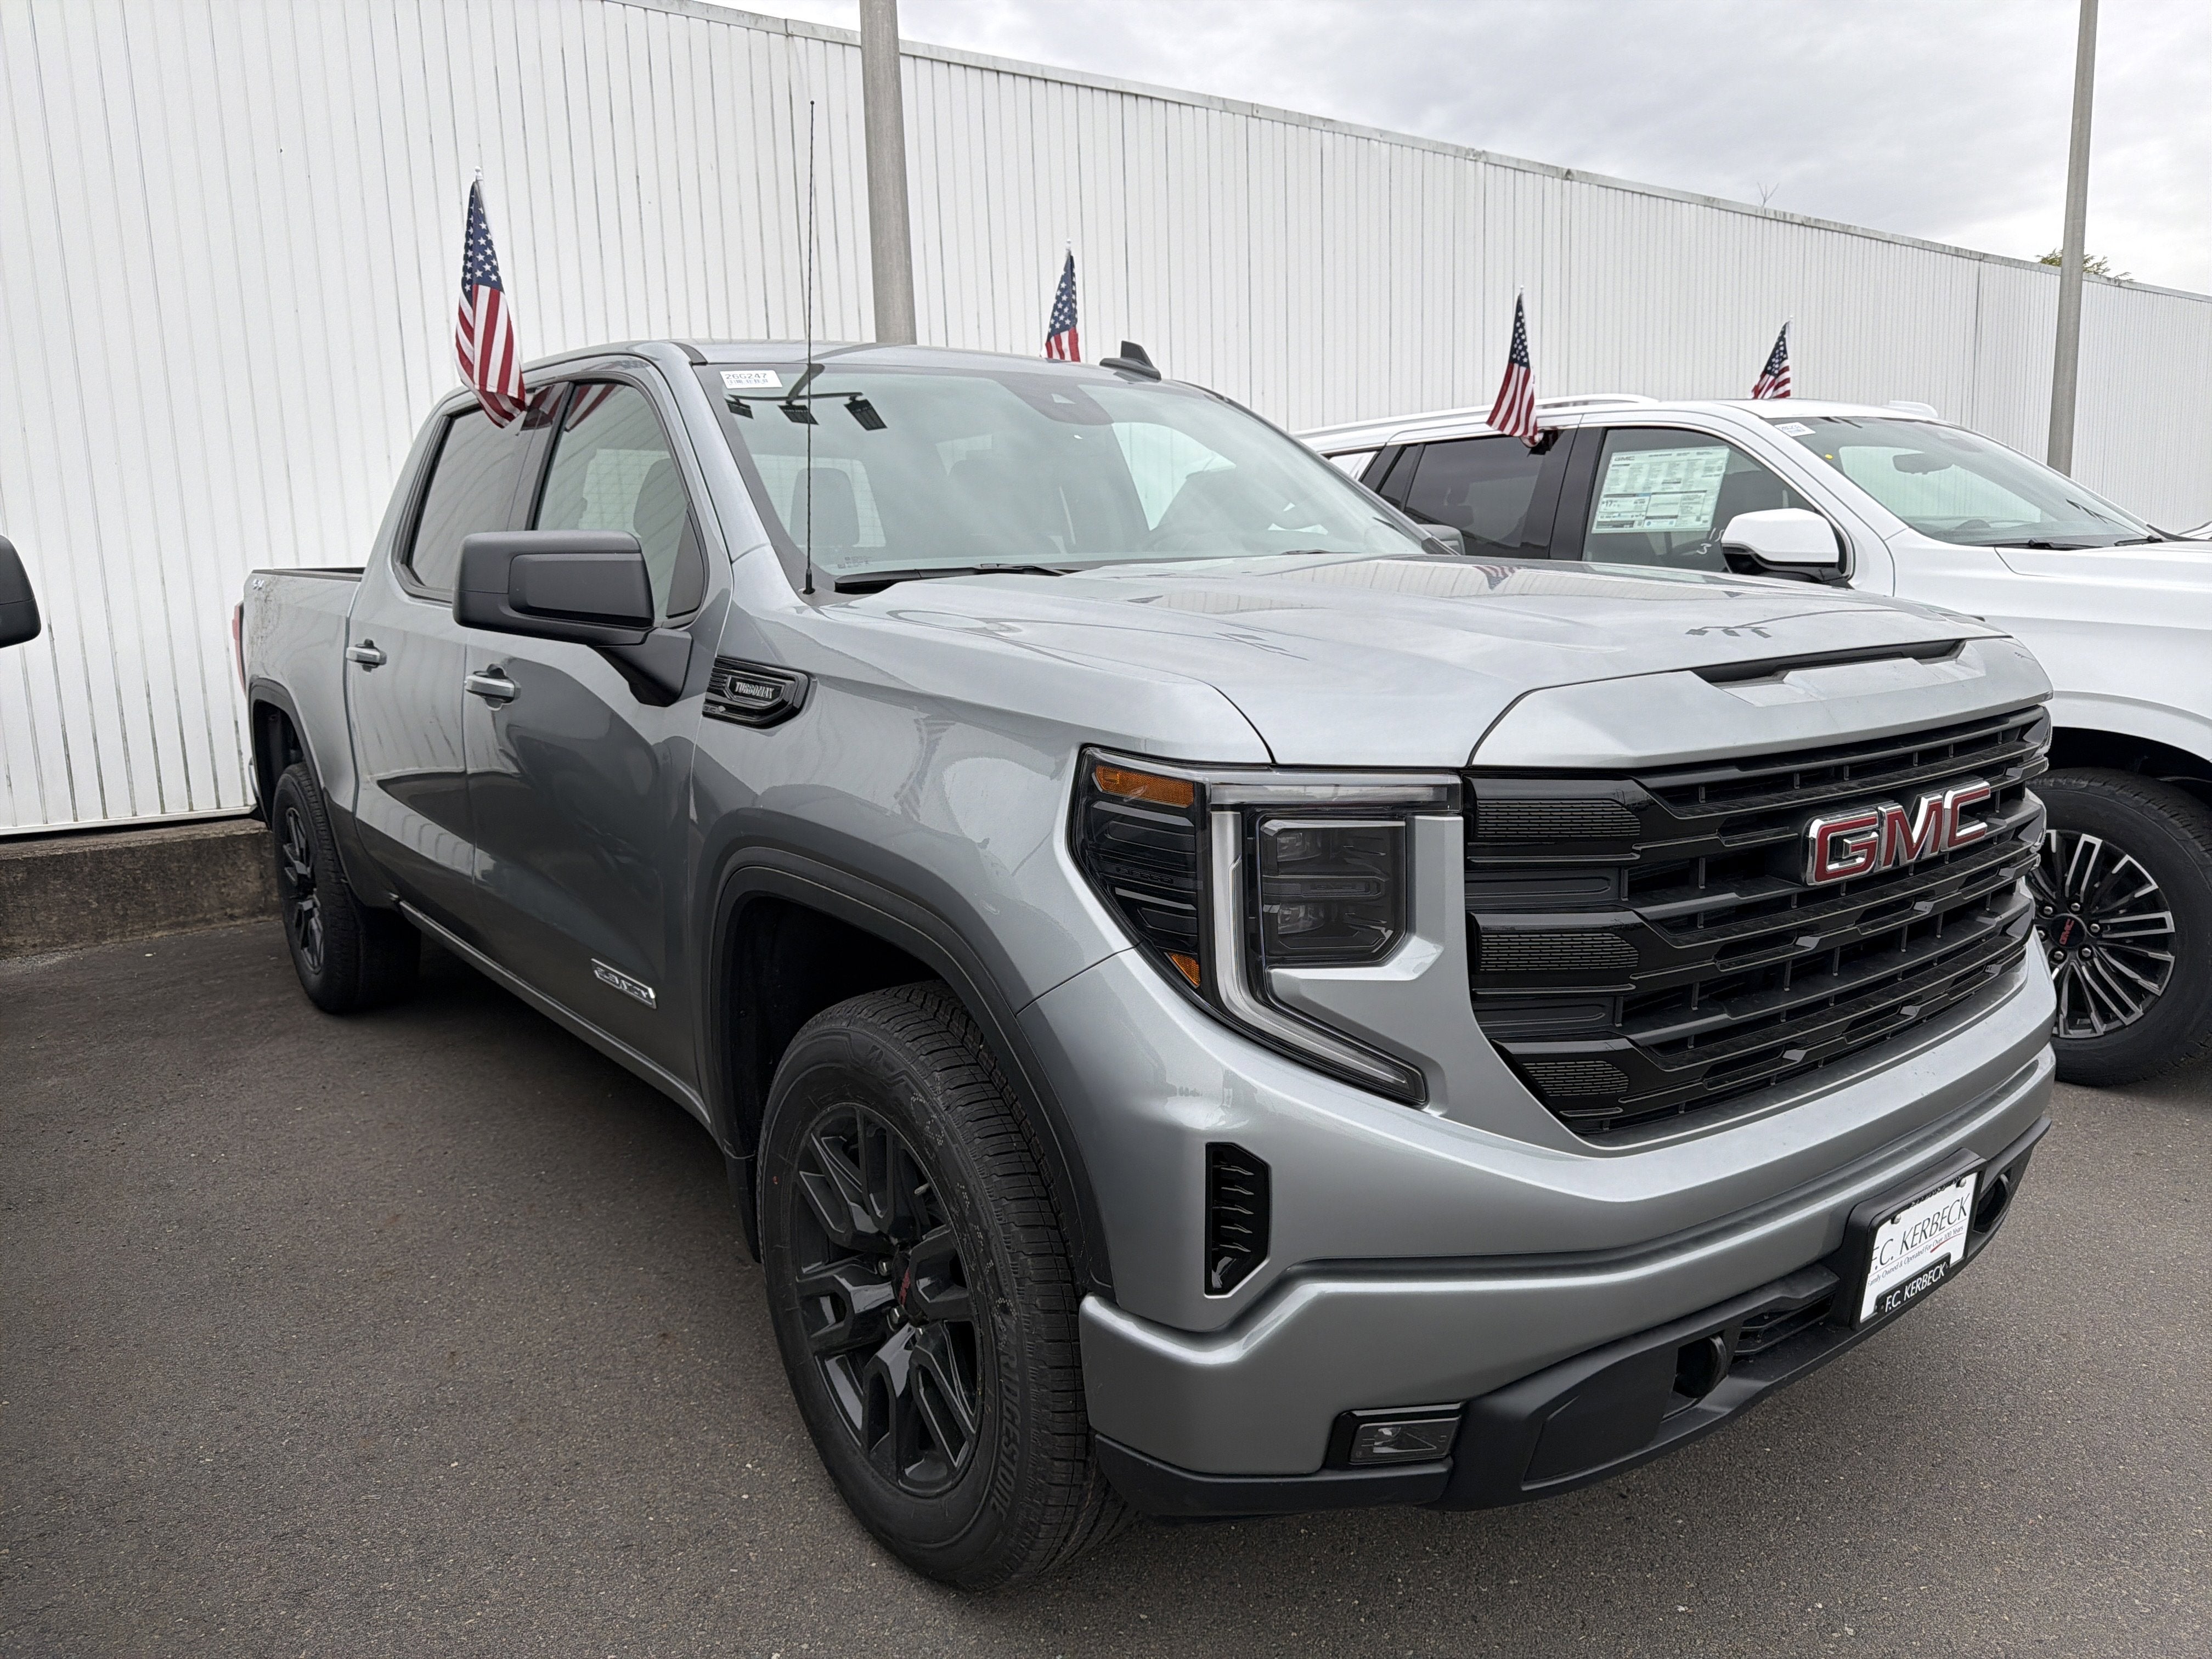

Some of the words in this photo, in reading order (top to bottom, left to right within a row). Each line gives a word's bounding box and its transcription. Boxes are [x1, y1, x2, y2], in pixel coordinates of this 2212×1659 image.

[1806, 780, 1991, 886] GMC
[1900, 1193, 1971, 1255] KERBECK
[1882, 1263, 1899, 1278] Owned
[1904, 1248, 1925, 1266] Operated
[1904, 1261, 1946, 1301] KERBECK
